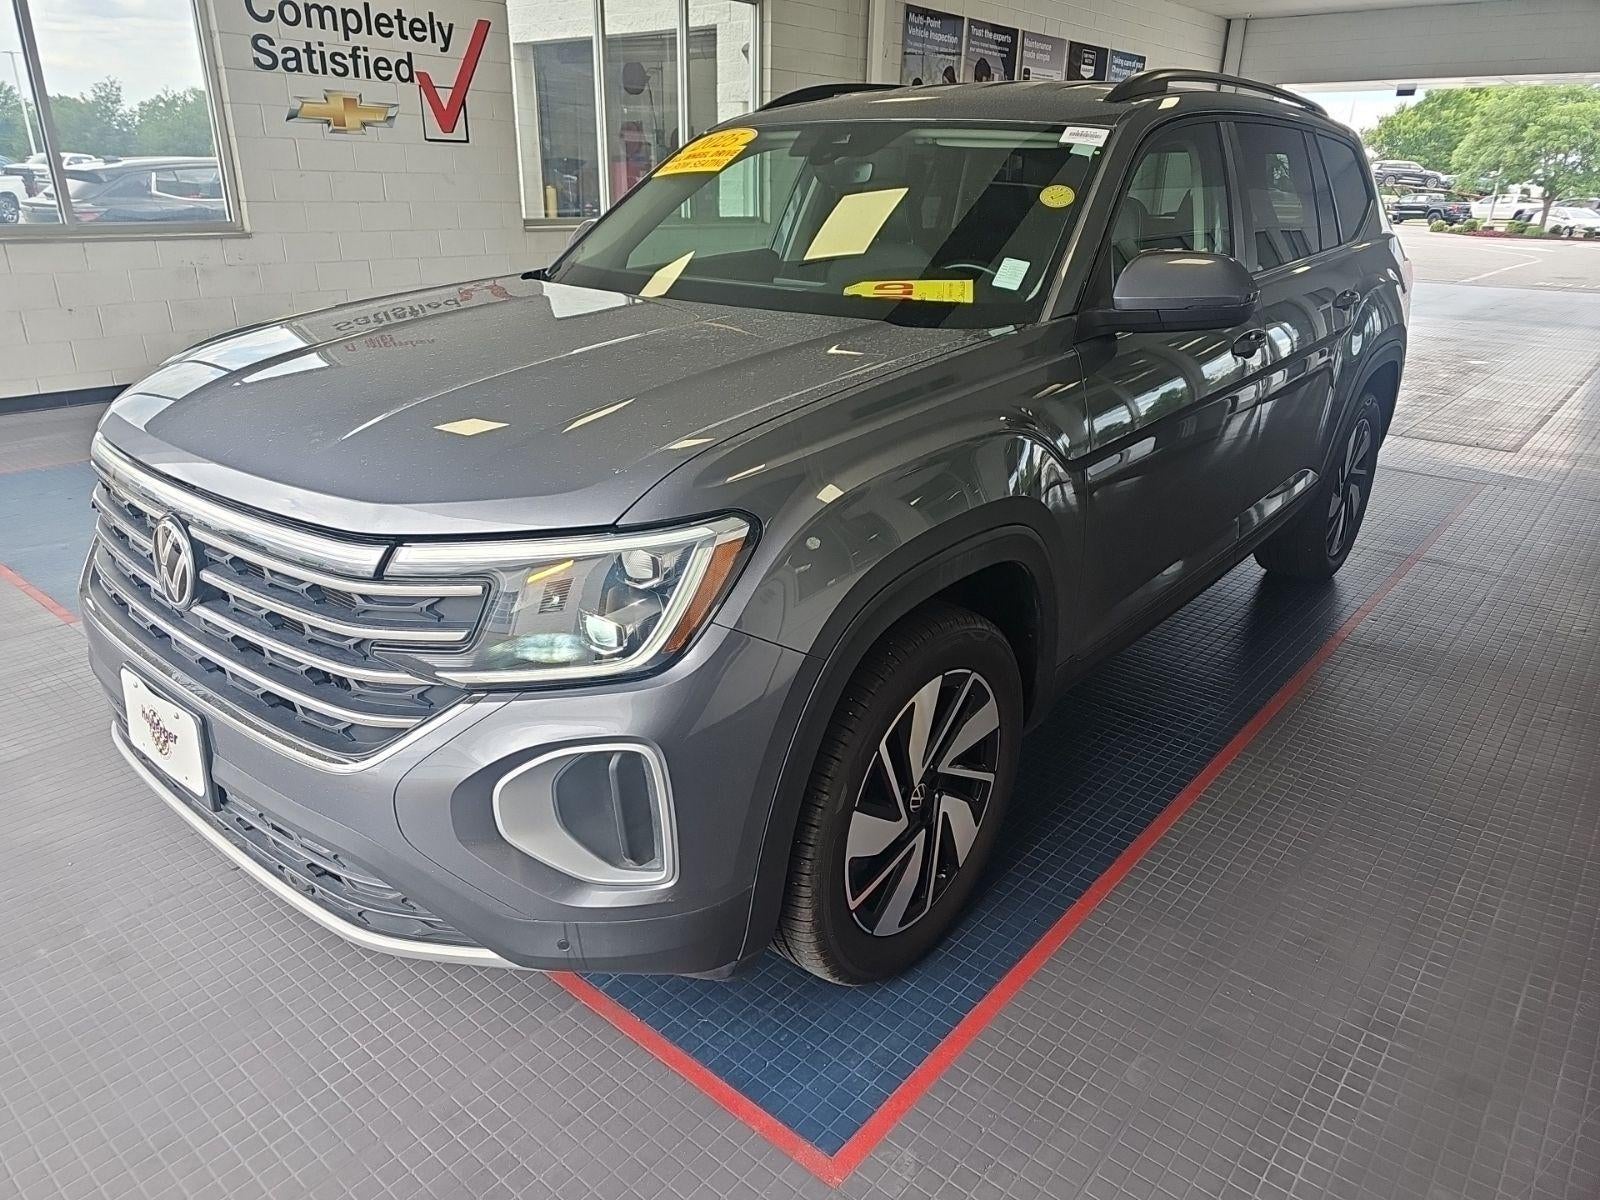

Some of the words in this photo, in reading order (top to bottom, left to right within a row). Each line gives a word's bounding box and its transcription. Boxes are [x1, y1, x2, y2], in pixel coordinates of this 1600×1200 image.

[247, 0, 454, 53] Completely
[908, 25, 929, 39] Vehicle
[929, 30, 959, 45] Inspection
[970, 25, 984, 37] Trust
[984, 29, 993, 39] the
[993, 32, 1012, 43] experts
[251, 33, 415, 84] Satisfied
